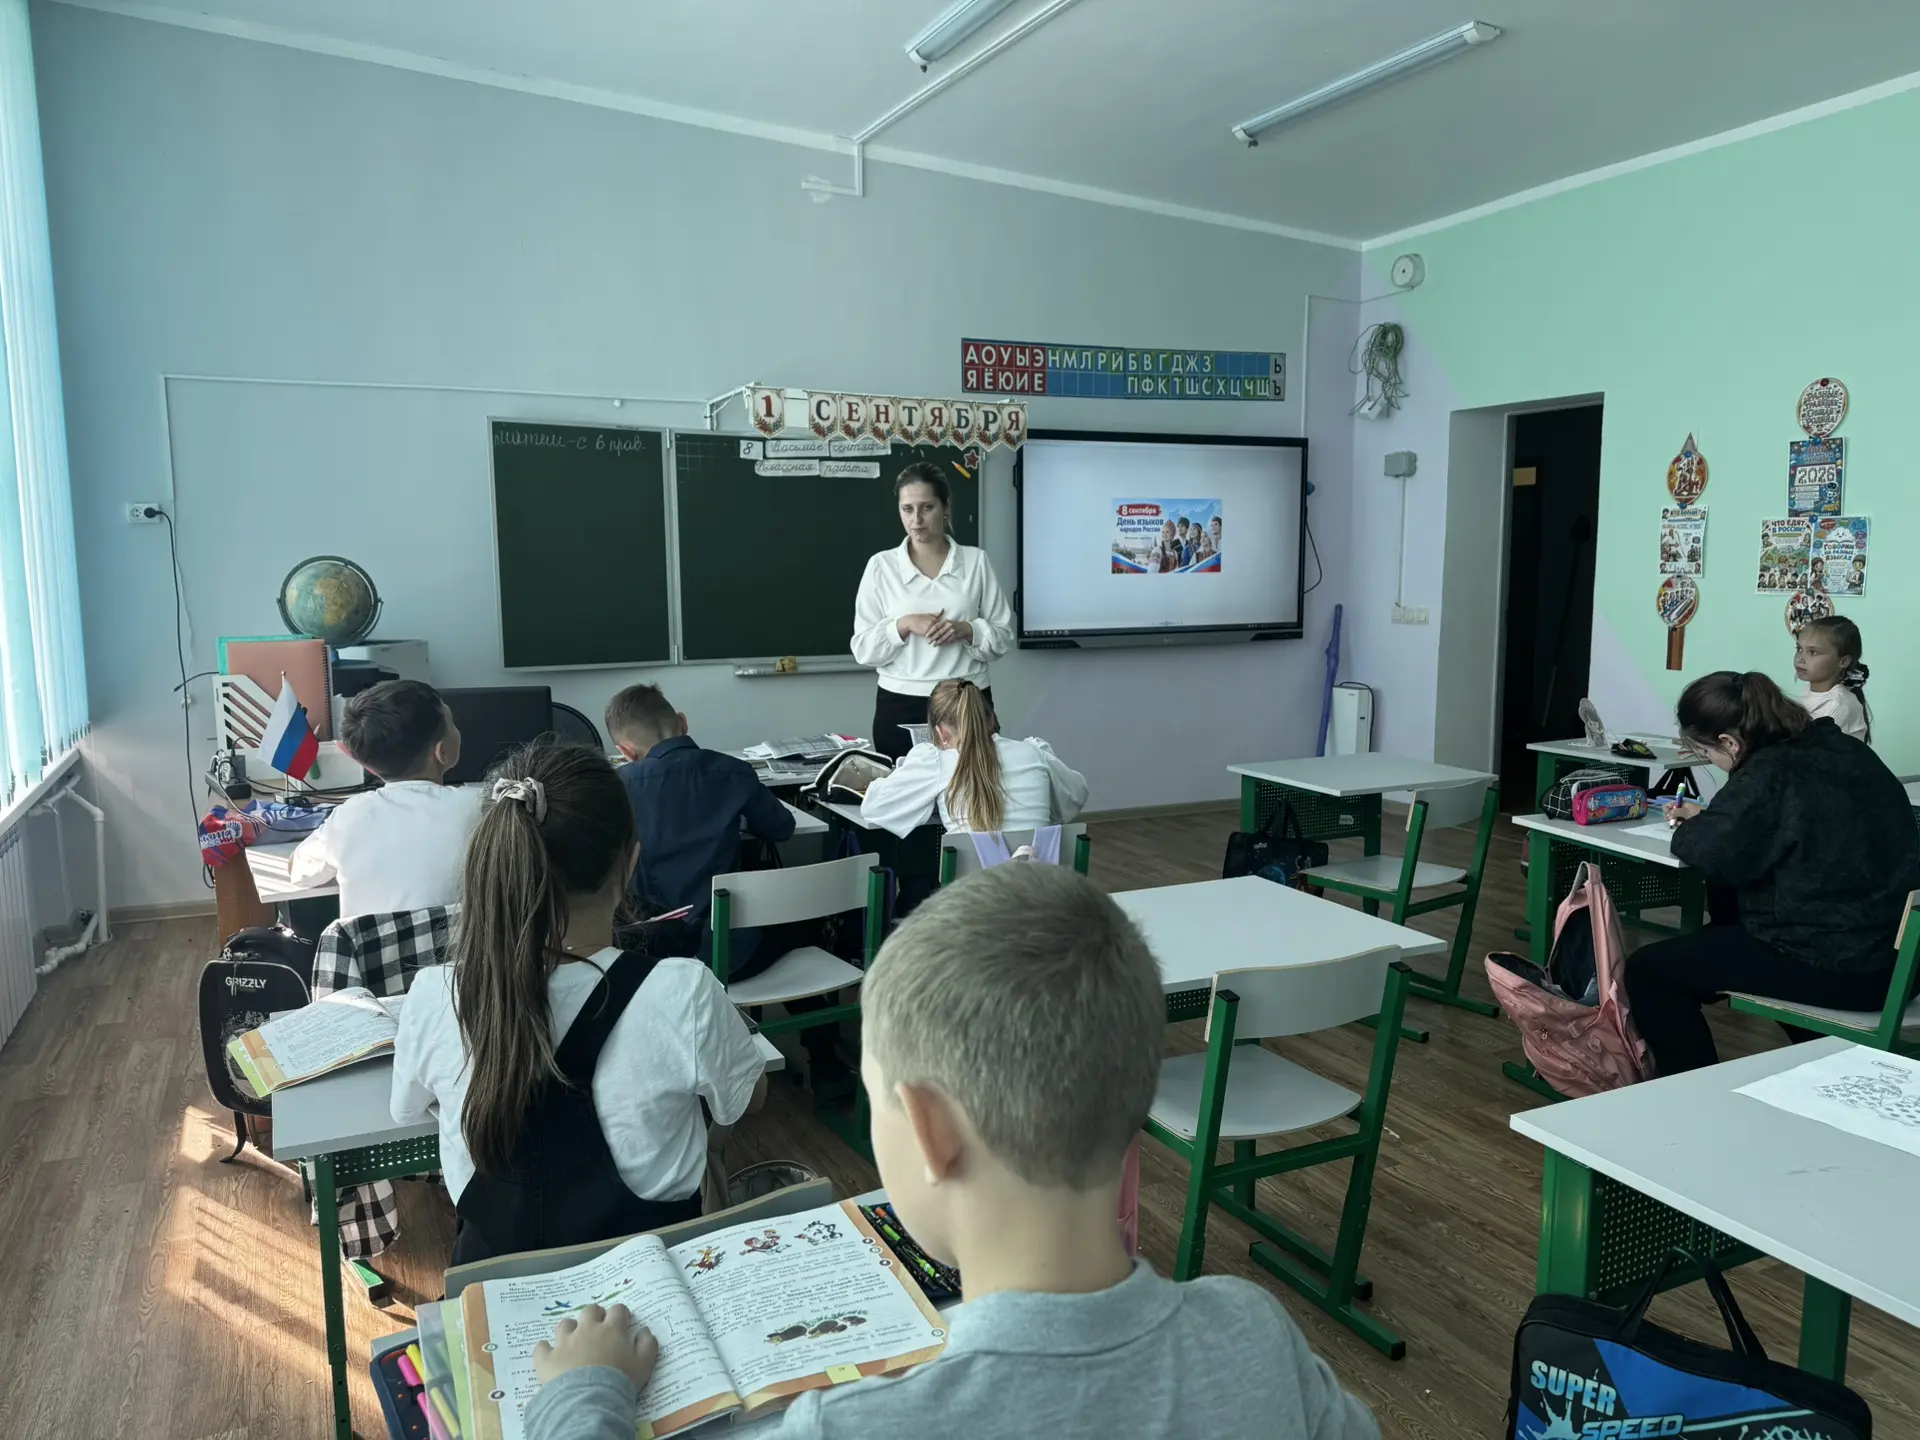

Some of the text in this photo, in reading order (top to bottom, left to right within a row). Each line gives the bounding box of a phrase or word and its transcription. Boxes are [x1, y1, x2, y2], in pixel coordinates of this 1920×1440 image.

[761, 394, 1021, 431] 1 СЕНТЯБРЯ
[742, 442, 754, 455] 8
[1798, 465, 1835, 484] 2026
[1121, 505, 1128, 516] 8
[1116, 517, 1164, 527] День языков
[225, 976, 267, 989] GRIZZLY
[1530, 1359, 1617, 1416] SUPER
[1580, 1413, 1685, 1440] SPEED
